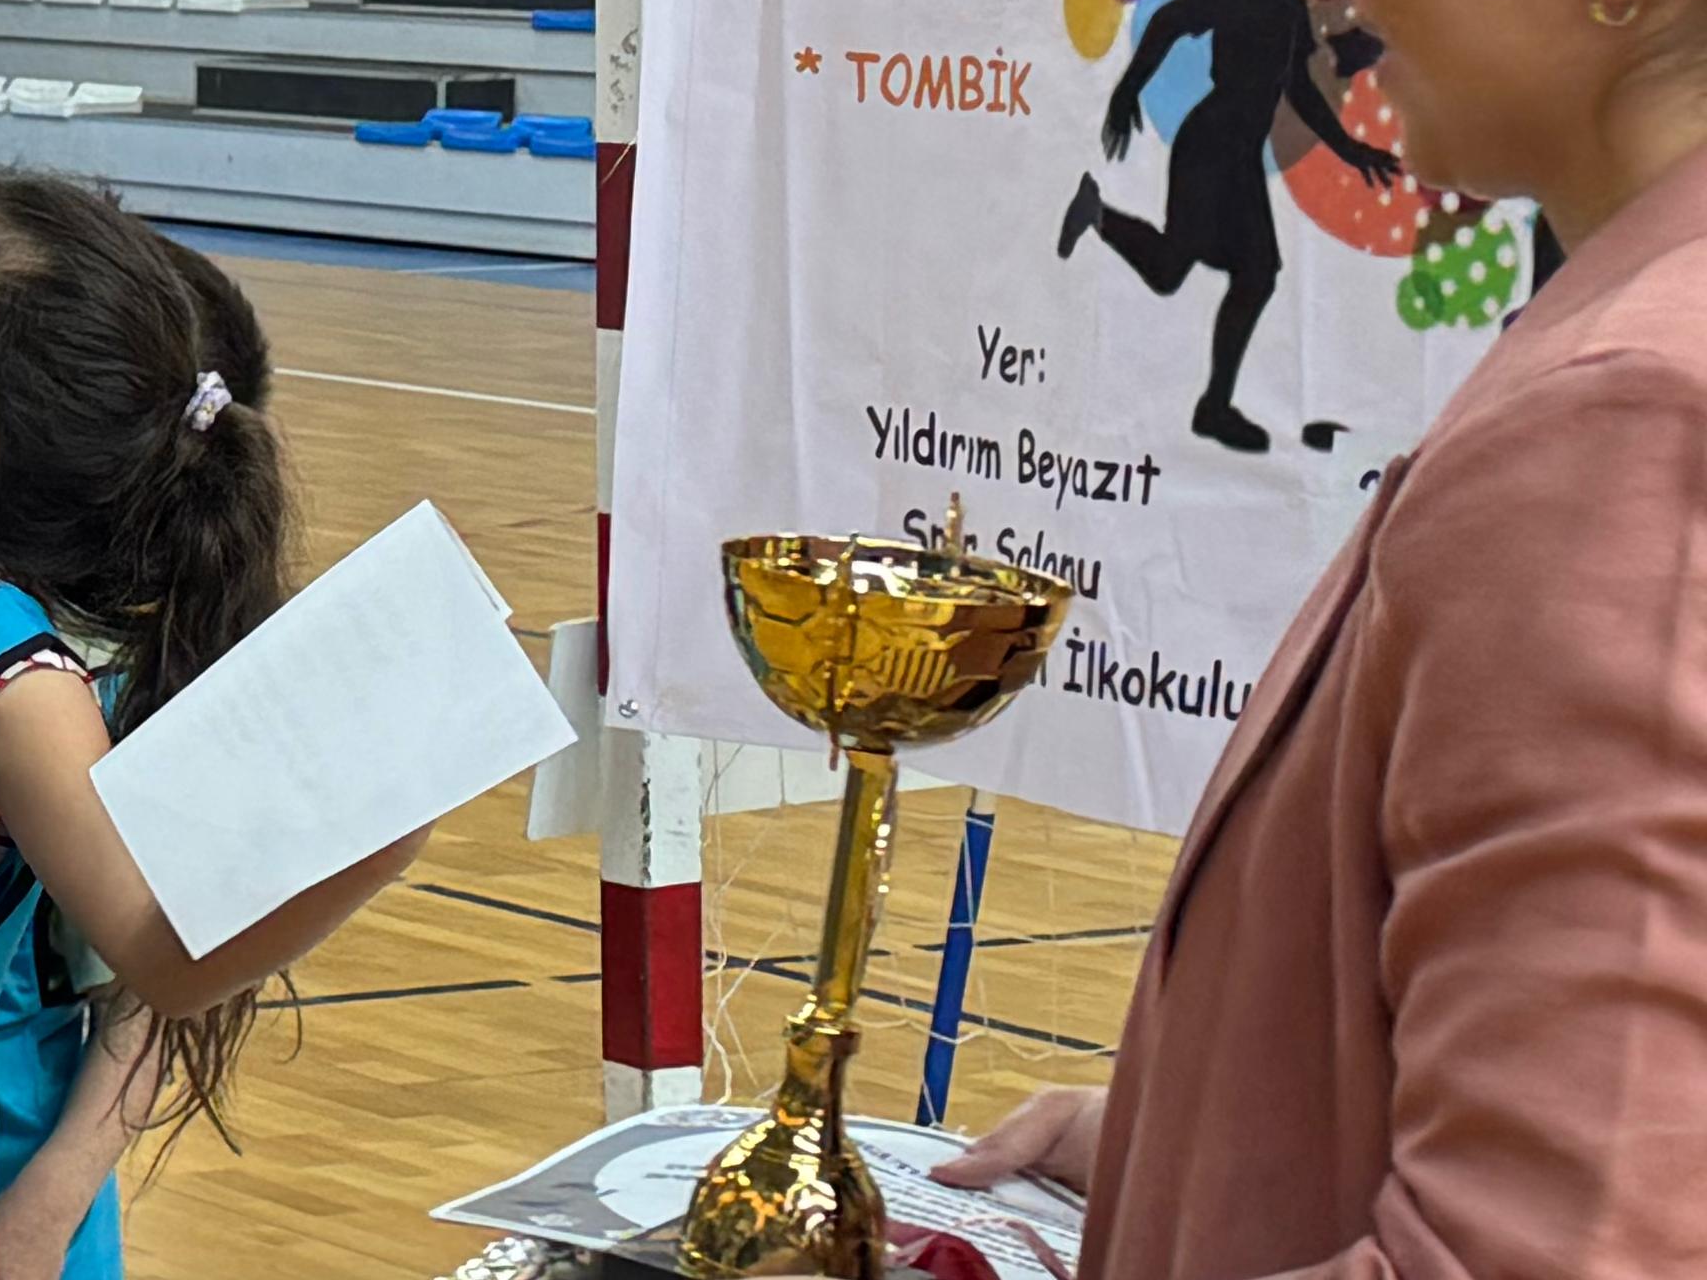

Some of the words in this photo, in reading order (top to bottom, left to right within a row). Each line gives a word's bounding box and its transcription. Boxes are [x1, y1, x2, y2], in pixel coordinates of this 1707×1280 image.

[845, 46, 1033, 116] TOMBİK
[977, 324, 1047, 385] Yer:
[1017, 428, 1161, 511] Beyazıt
